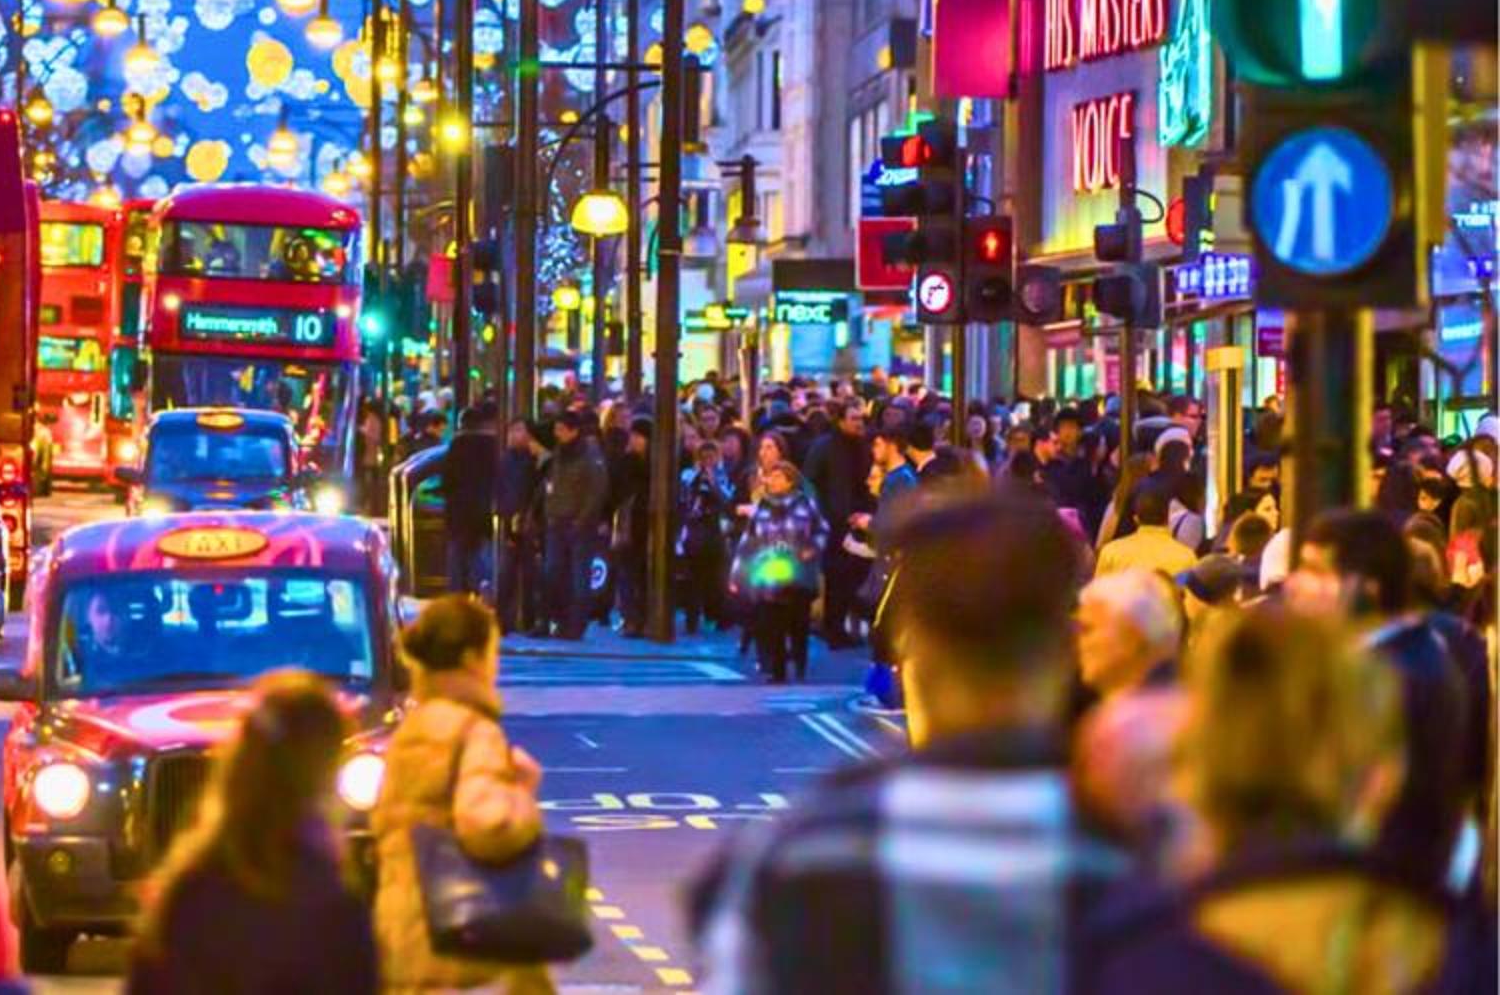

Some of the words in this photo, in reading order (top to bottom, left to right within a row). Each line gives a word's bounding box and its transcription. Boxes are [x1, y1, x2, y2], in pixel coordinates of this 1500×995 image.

[777, 303, 832, 323] next
[186, 312, 279, 334] Hammersmith
[295, 315, 322, 342] 10
[184, 535, 241, 552] TAXI
